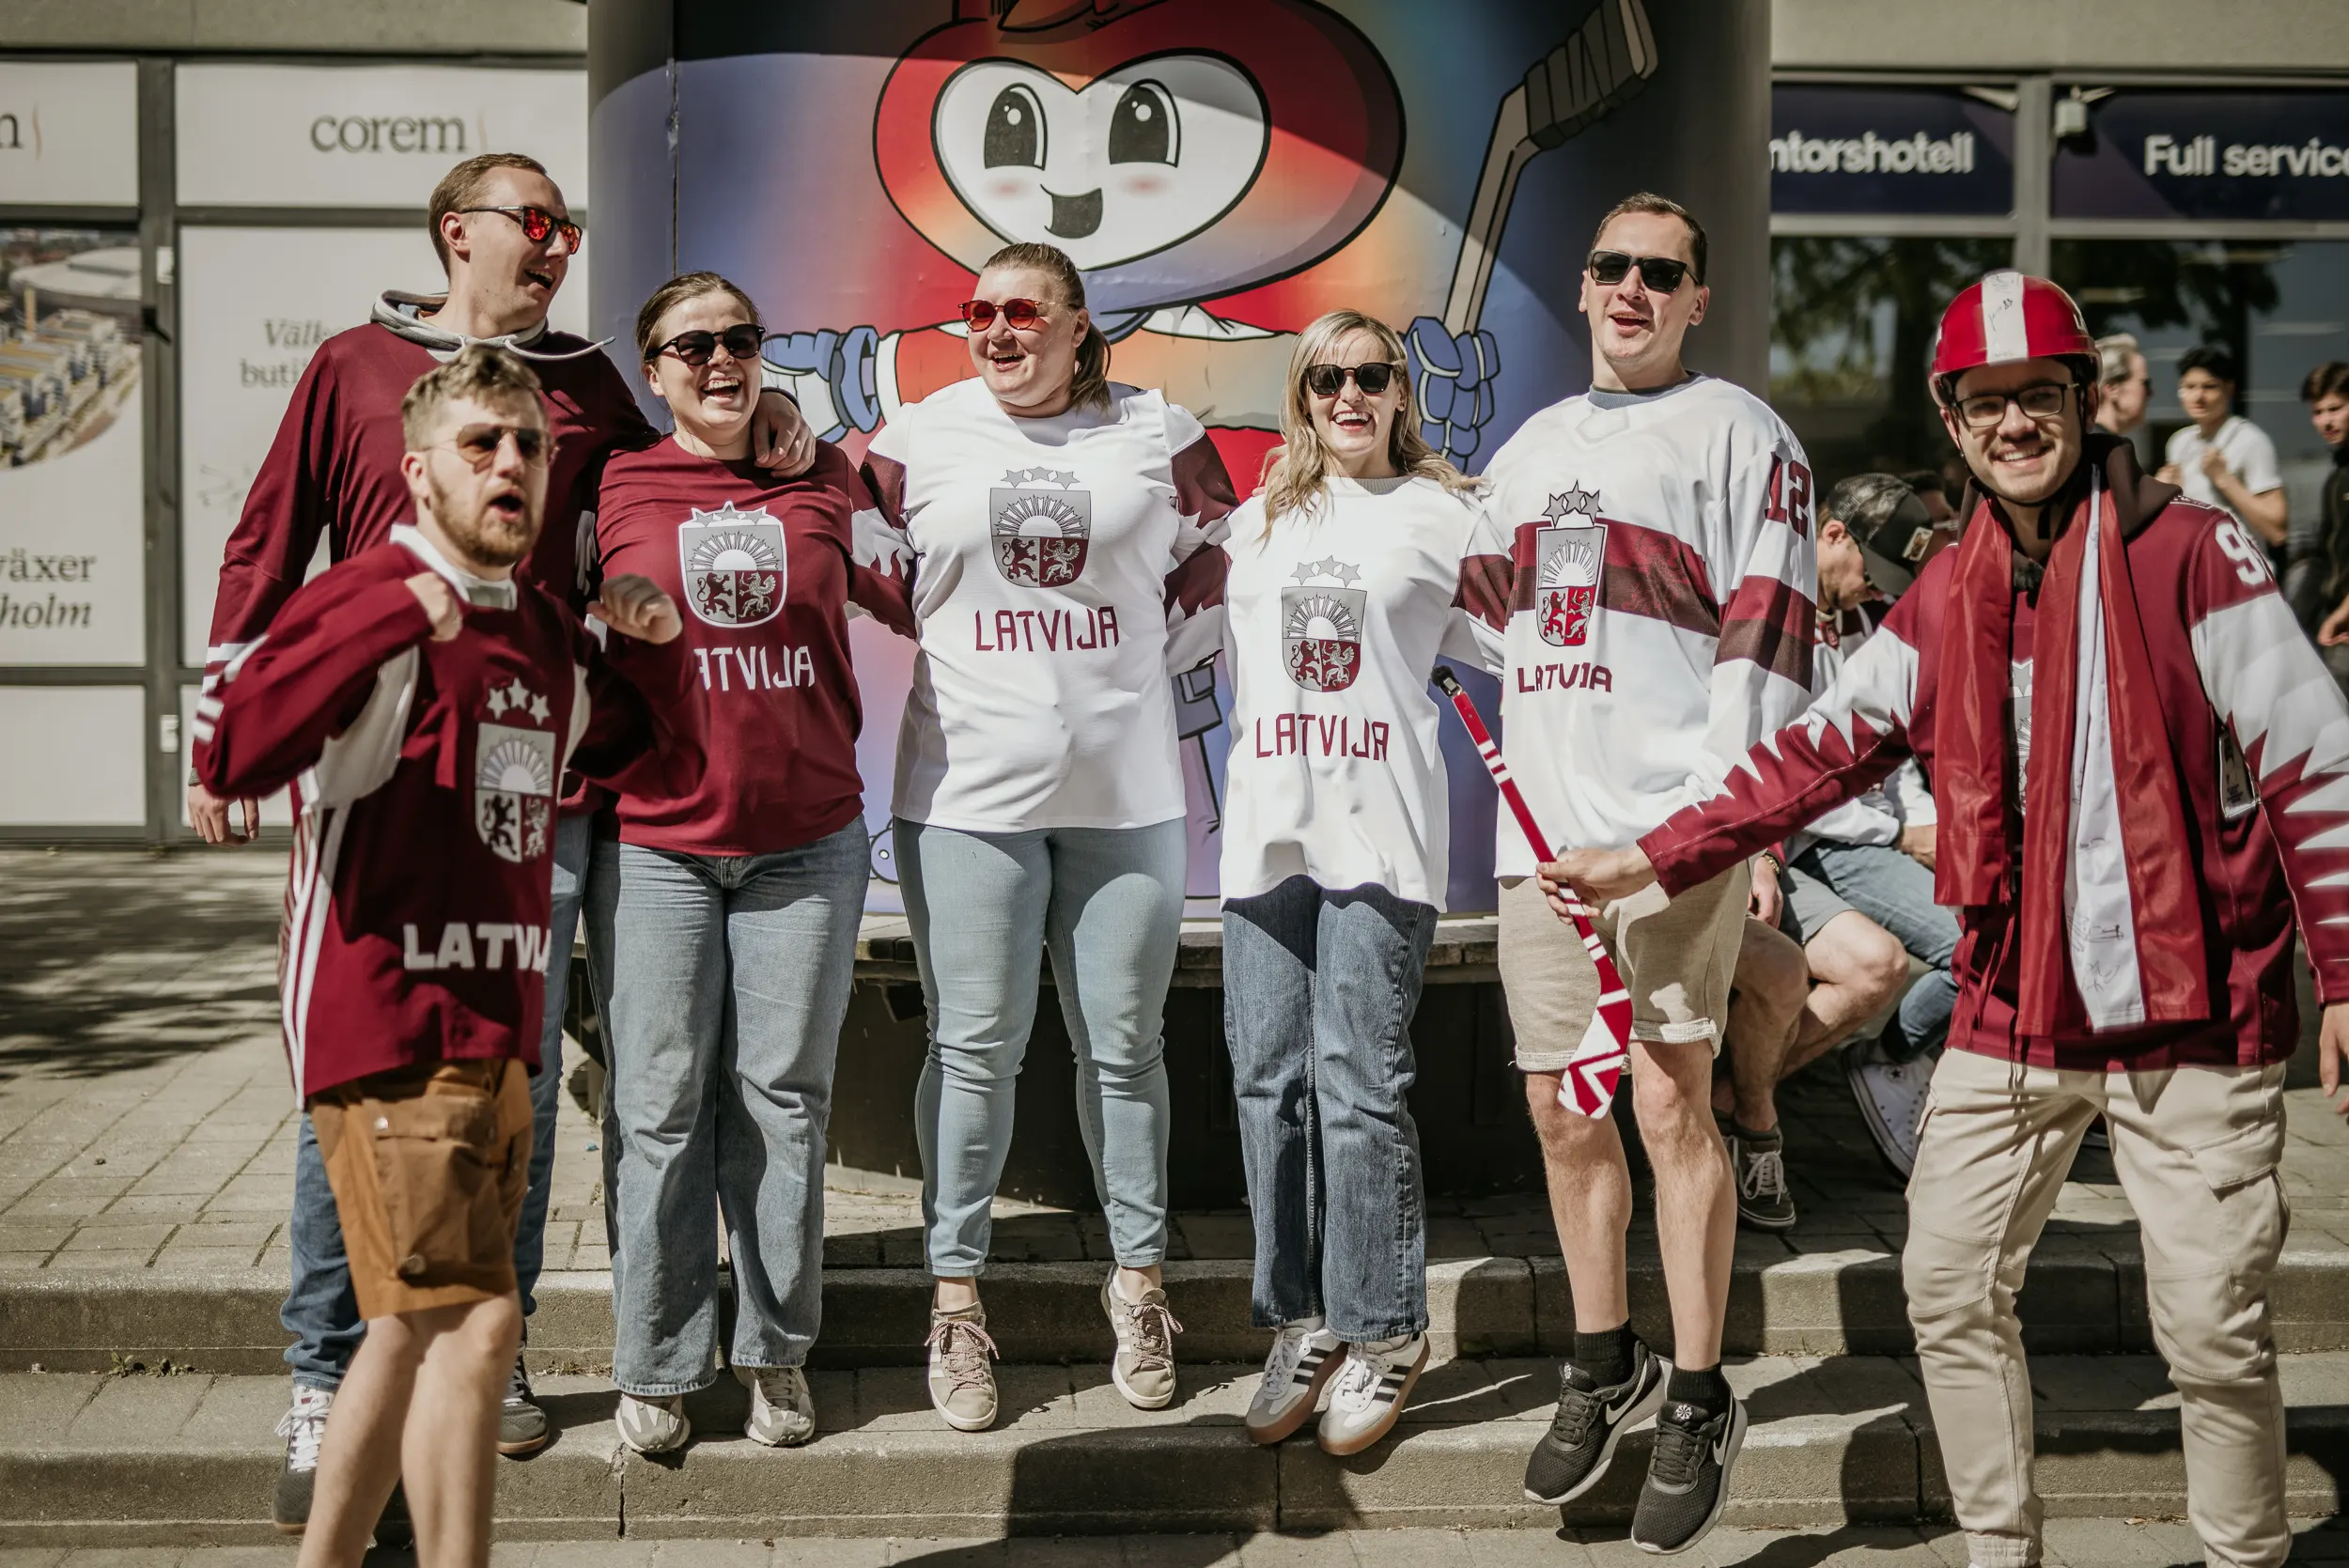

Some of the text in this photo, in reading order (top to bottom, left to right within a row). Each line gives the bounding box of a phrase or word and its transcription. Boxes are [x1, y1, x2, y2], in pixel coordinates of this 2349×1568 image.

[310, 114, 467, 153] corem
[2143, 134, 2217, 177] Full
[1764, 451, 1812, 541] 12
[974, 605, 1120, 652] LATVIJA
[1517, 661, 1613, 693] LATVIA
[1256, 711, 1390, 762] LATVIJA
